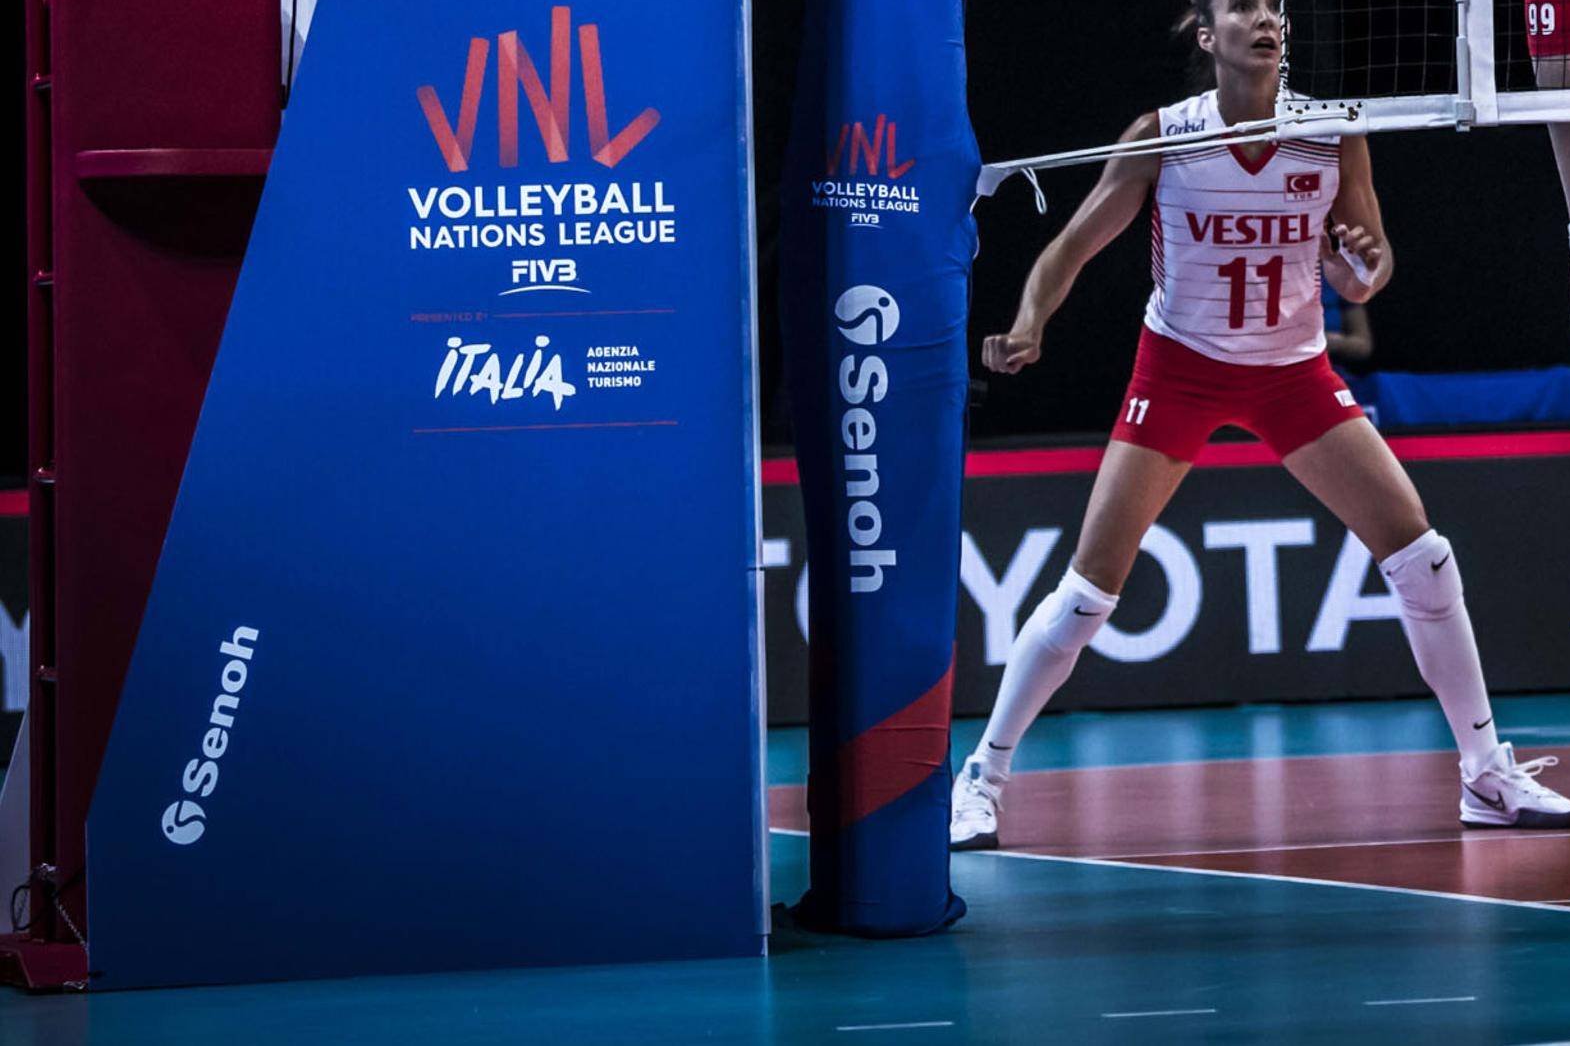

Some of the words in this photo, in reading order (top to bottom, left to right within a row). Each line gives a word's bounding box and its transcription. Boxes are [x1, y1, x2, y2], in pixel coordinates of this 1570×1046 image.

[1529, 3, 1556, 36] 99
[417, 5, 662, 172] VNL
[408, 181, 676, 219] VOLLEYBALL
[811, 180, 920, 201] VOLLEYBALL
[812, 196, 867, 209] NATIONS
[871, 199, 920, 213] LEAGUE
[851, 212, 880, 225] FIVB
[1185, 211, 1316, 245] VESTEL
[410, 223, 546, 250] NATIONS
[558, 219, 677, 246] LEAGUE
[511, 258, 578, 283] FIVB
[1218, 255, 1284, 329] 11
[586, 345, 639, 358] AGENZIA
[587, 360, 656, 374] NAZIONALE
[587, 375, 642, 389] TURISMO
[1125, 397, 1150, 425] 11
[838, 353, 897, 594] Senoh
[182, 625, 260, 797] Senoh
